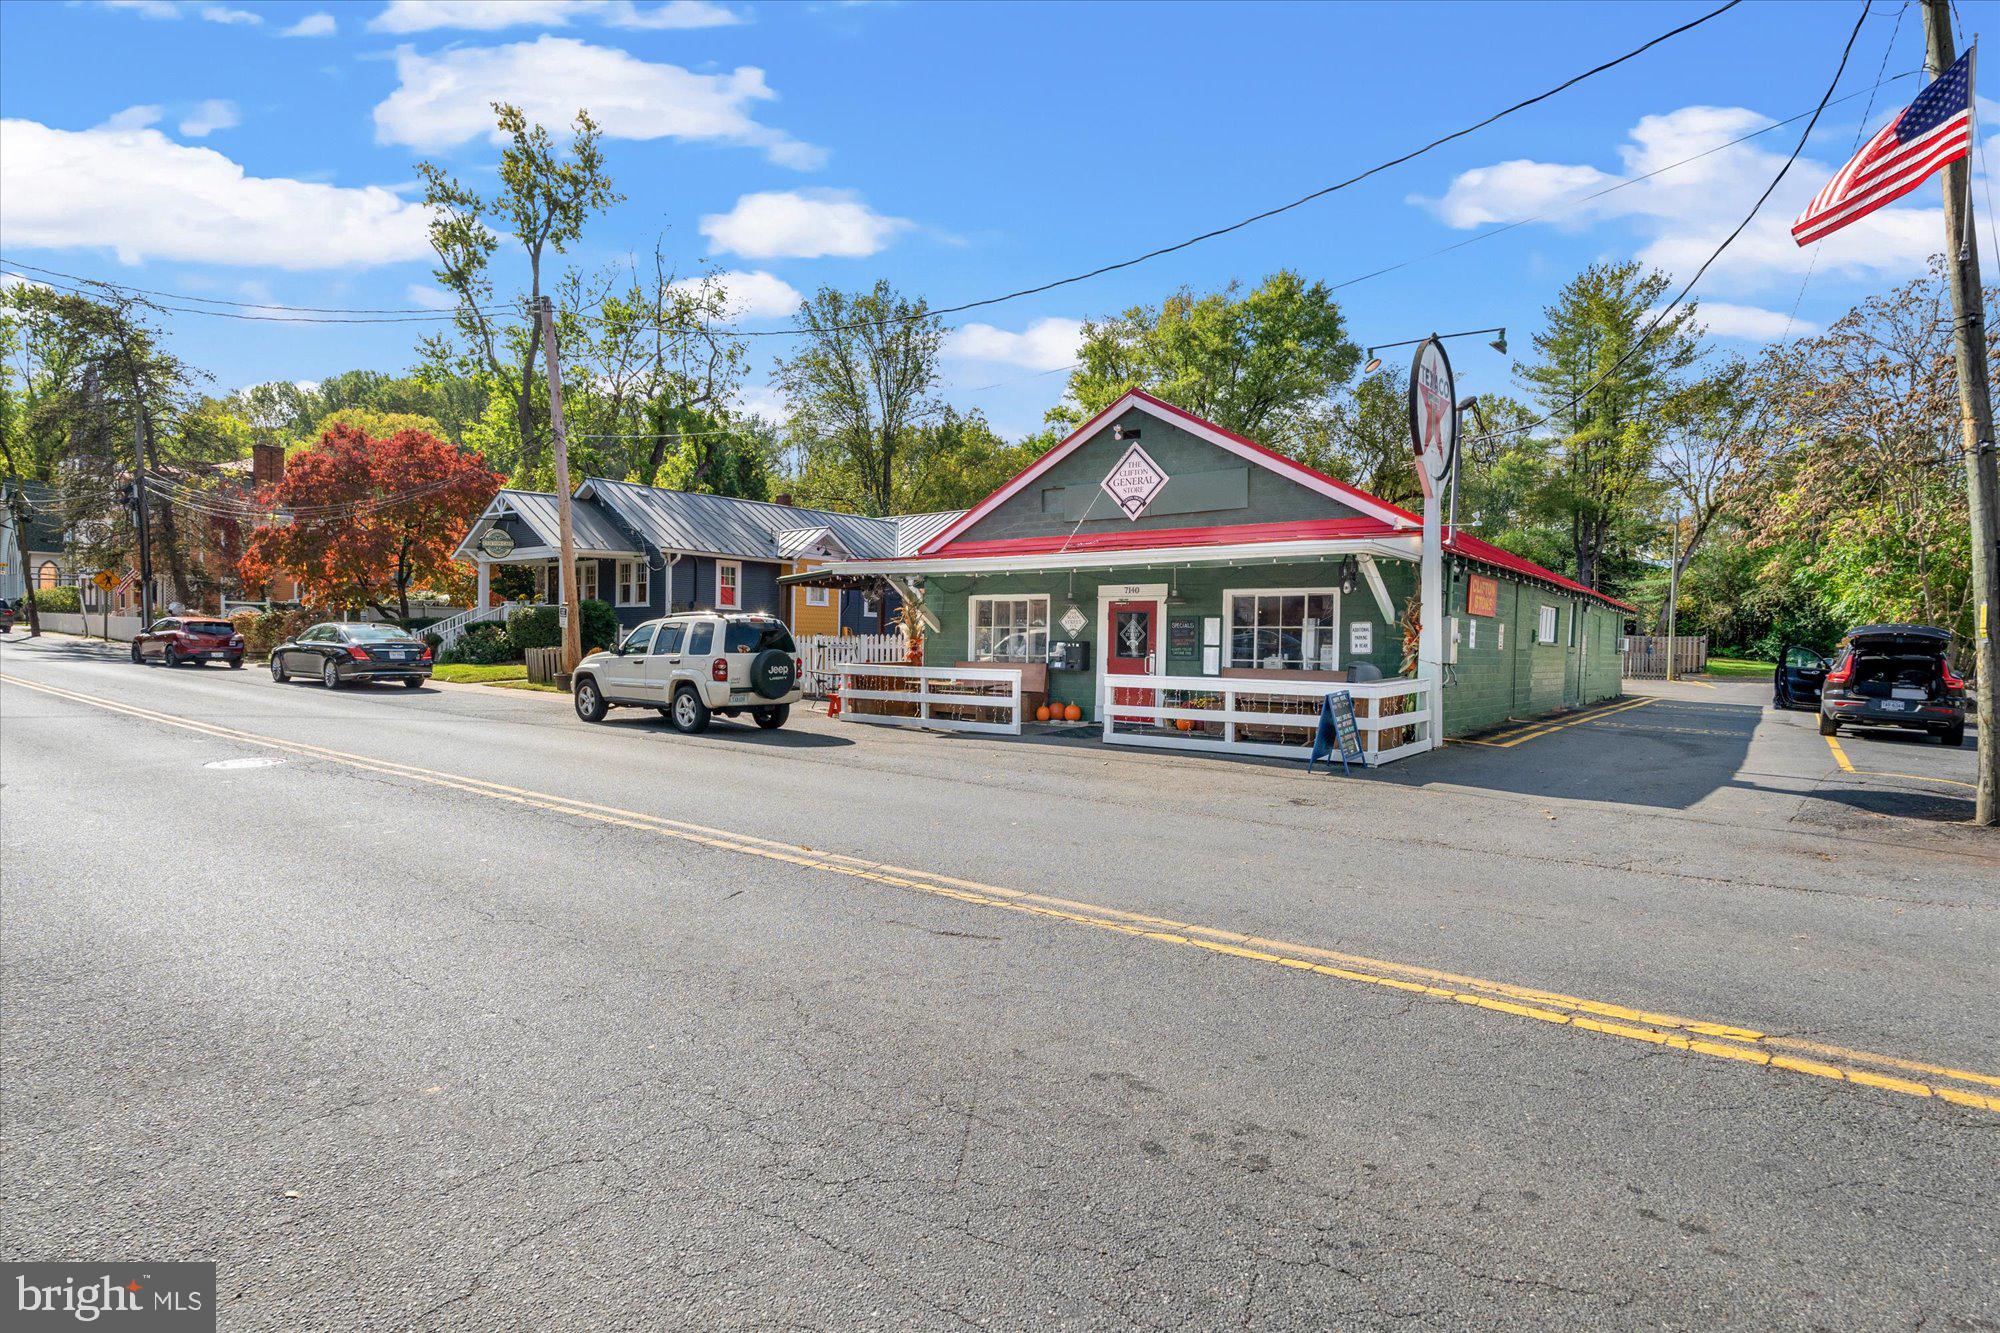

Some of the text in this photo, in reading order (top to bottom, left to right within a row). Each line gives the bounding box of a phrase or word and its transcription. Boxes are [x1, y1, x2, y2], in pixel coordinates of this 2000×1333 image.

[1420, 364, 1450, 399] TEXACO
[1120, 468, 1149, 477] CLIFTON
[1113, 476, 1155, 487] GENERAL
[1124, 586, 1140, 594] 7140
[768, 665, 789, 675] Jeep
